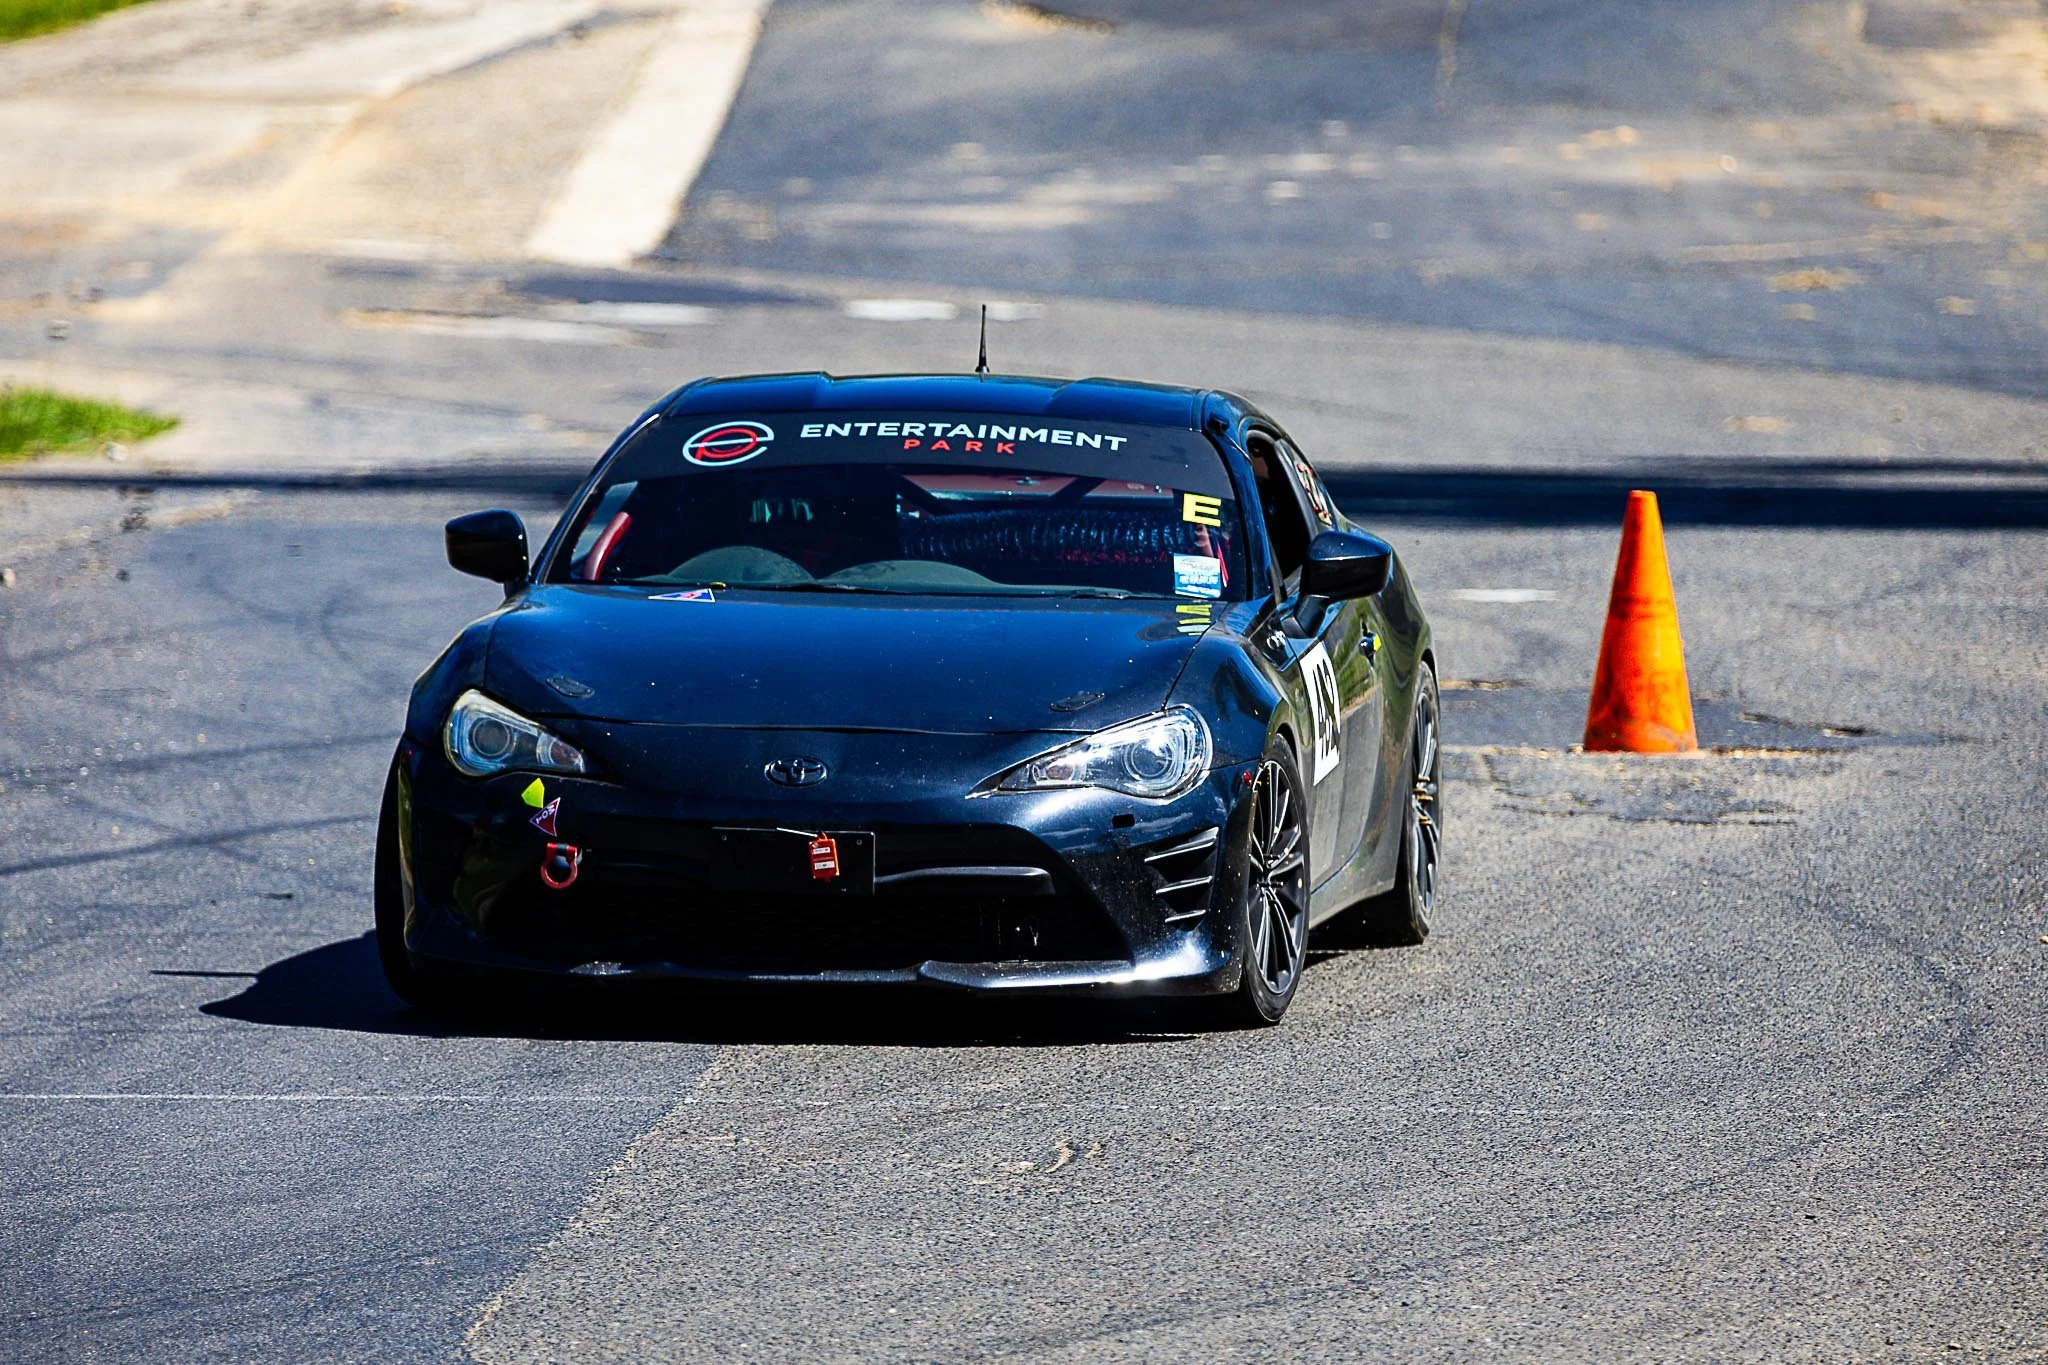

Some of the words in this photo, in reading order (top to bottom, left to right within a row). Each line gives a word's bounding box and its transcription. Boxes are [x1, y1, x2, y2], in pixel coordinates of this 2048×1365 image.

[800, 422, 1128, 451] ENTERTAINMENT
[903, 439, 1015, 454] PARK
[1183, 493, 1221, 527] E
[535, 804, 556, 825] TOW
